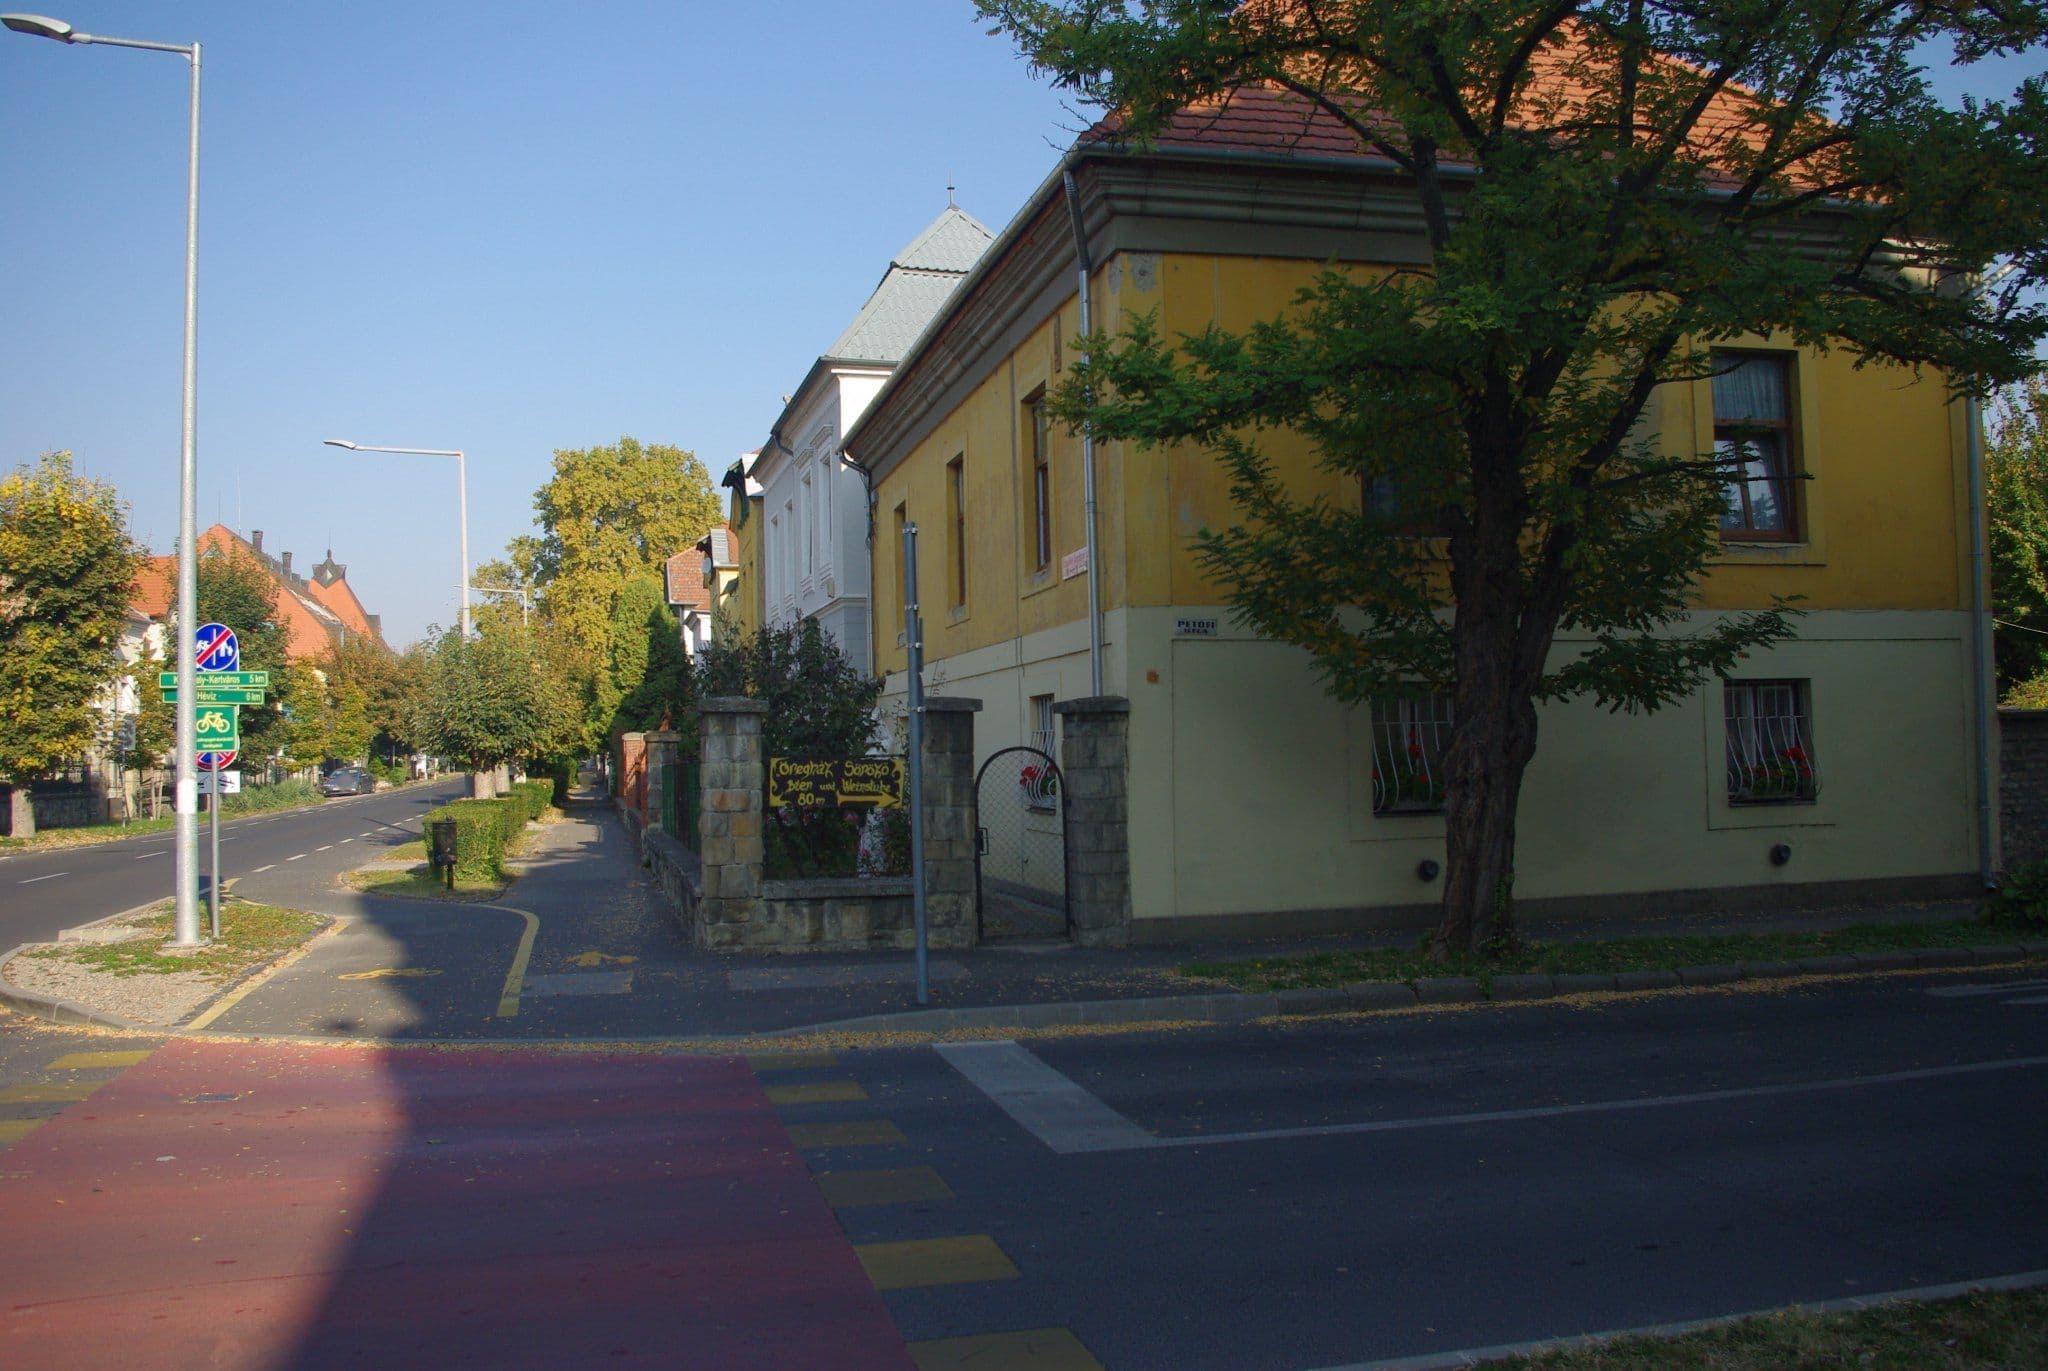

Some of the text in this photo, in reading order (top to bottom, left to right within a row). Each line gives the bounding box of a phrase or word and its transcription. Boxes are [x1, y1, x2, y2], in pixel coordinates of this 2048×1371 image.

[249, 675, 254, 683] 5
[255, 675, 265, 683] km
[252, 693, 261, 701] km
[819, 781, 836, 791] und
